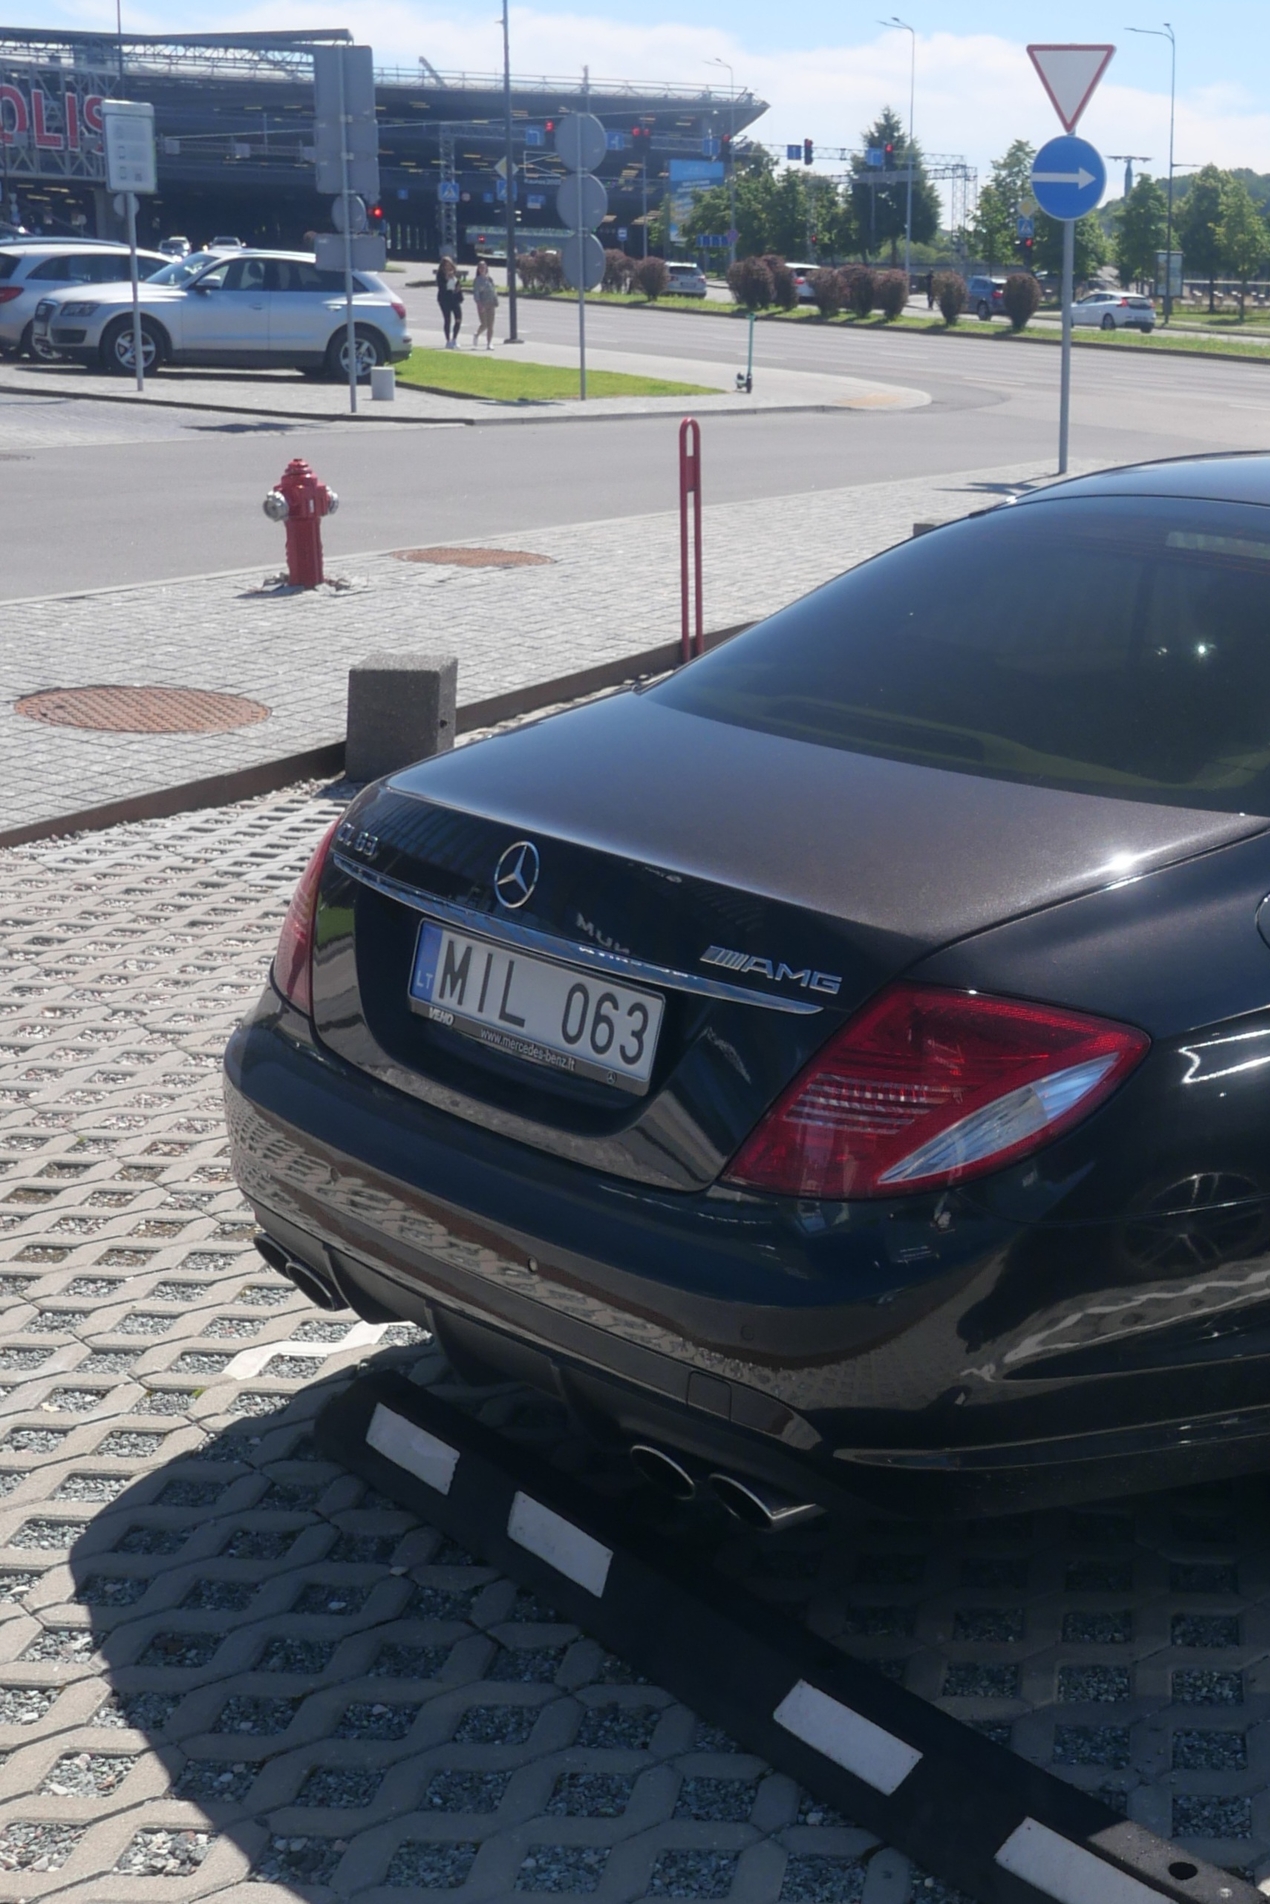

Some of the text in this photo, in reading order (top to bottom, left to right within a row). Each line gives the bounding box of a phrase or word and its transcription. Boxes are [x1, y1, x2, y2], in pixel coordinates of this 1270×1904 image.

[416, 970, 433, 989] LT
[741, 956, 843, 995] AMG
[428, 1006, 454, 1026] VEHO
[439, 941, 649, 1066] MIL 063
[480, 1028, 577, 1072] www.mercedes-benz.lt
